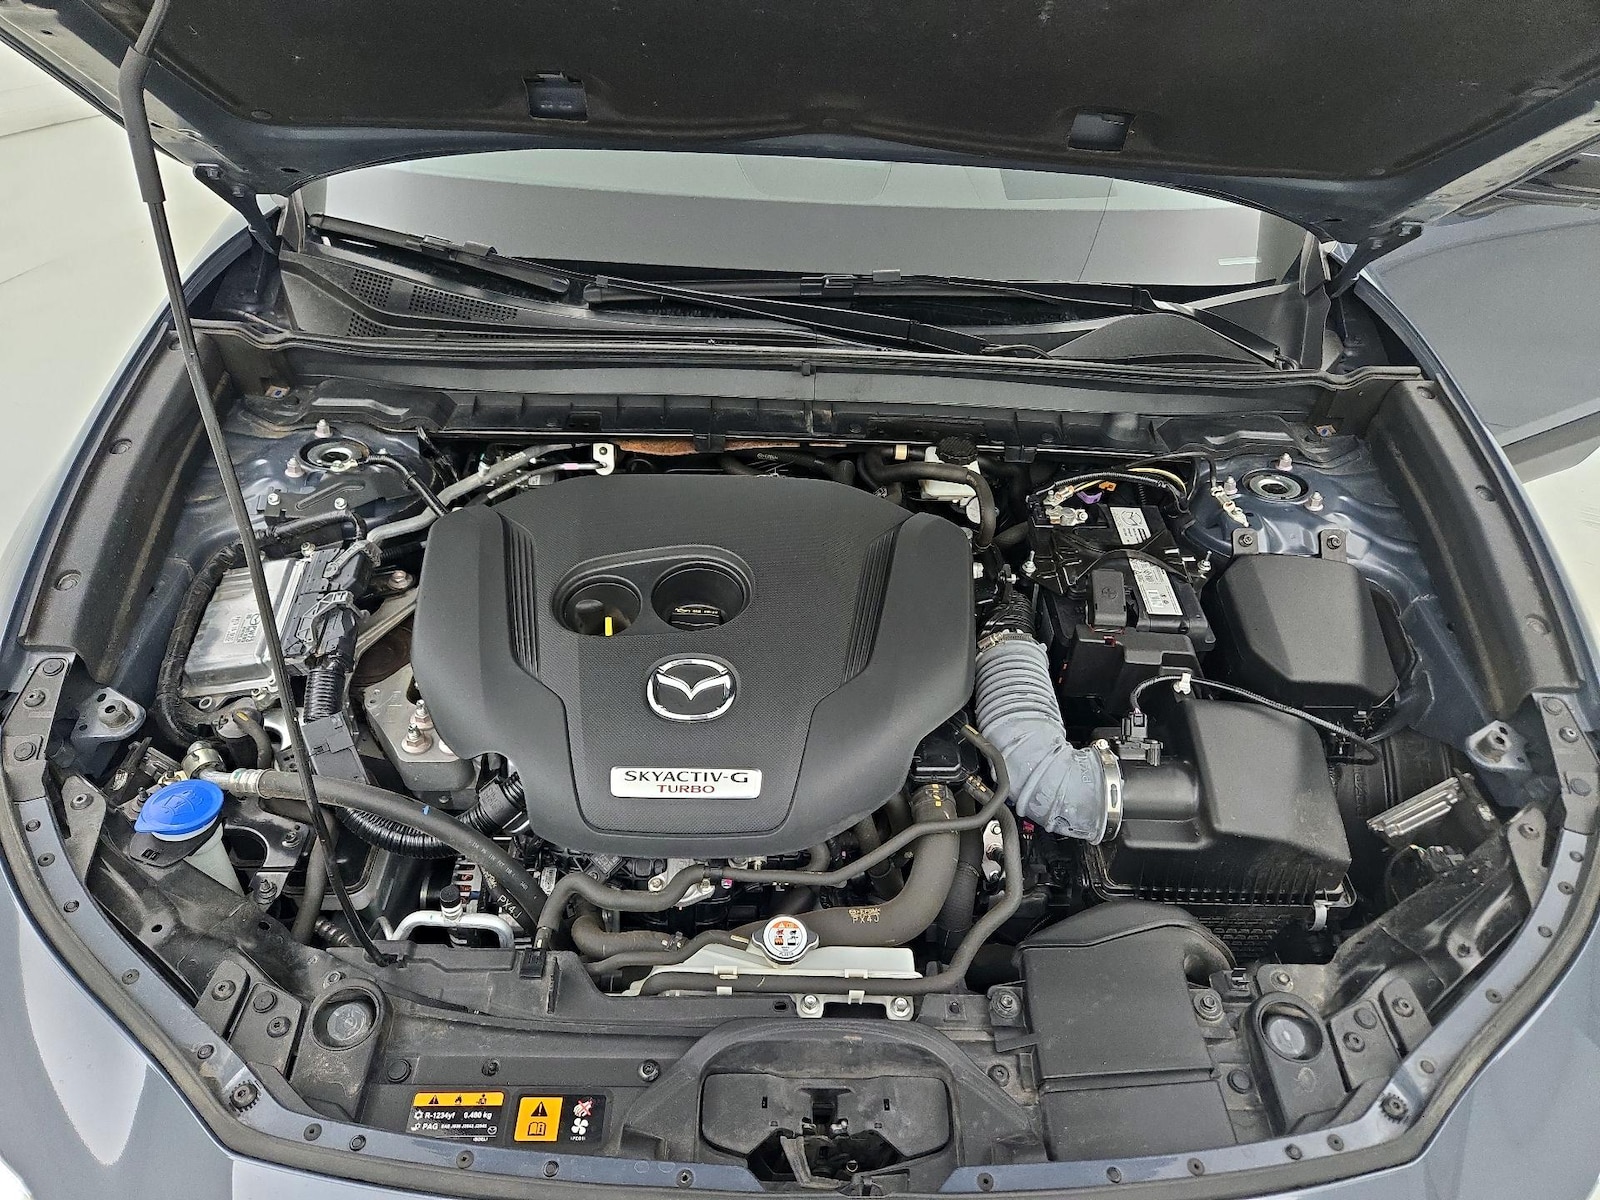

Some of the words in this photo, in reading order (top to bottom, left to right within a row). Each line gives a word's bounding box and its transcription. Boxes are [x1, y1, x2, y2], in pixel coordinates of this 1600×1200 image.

[624, 770, 748, 783] SKYACTIV-G
[657, 785, 715, 794] TURBO
[497, 894, 523, 919] PX4J
[853, 914, 880, 924] PX4J
[483, 1111, 493, 1121] kg
[422, 1122, 439, 1131] PAG
